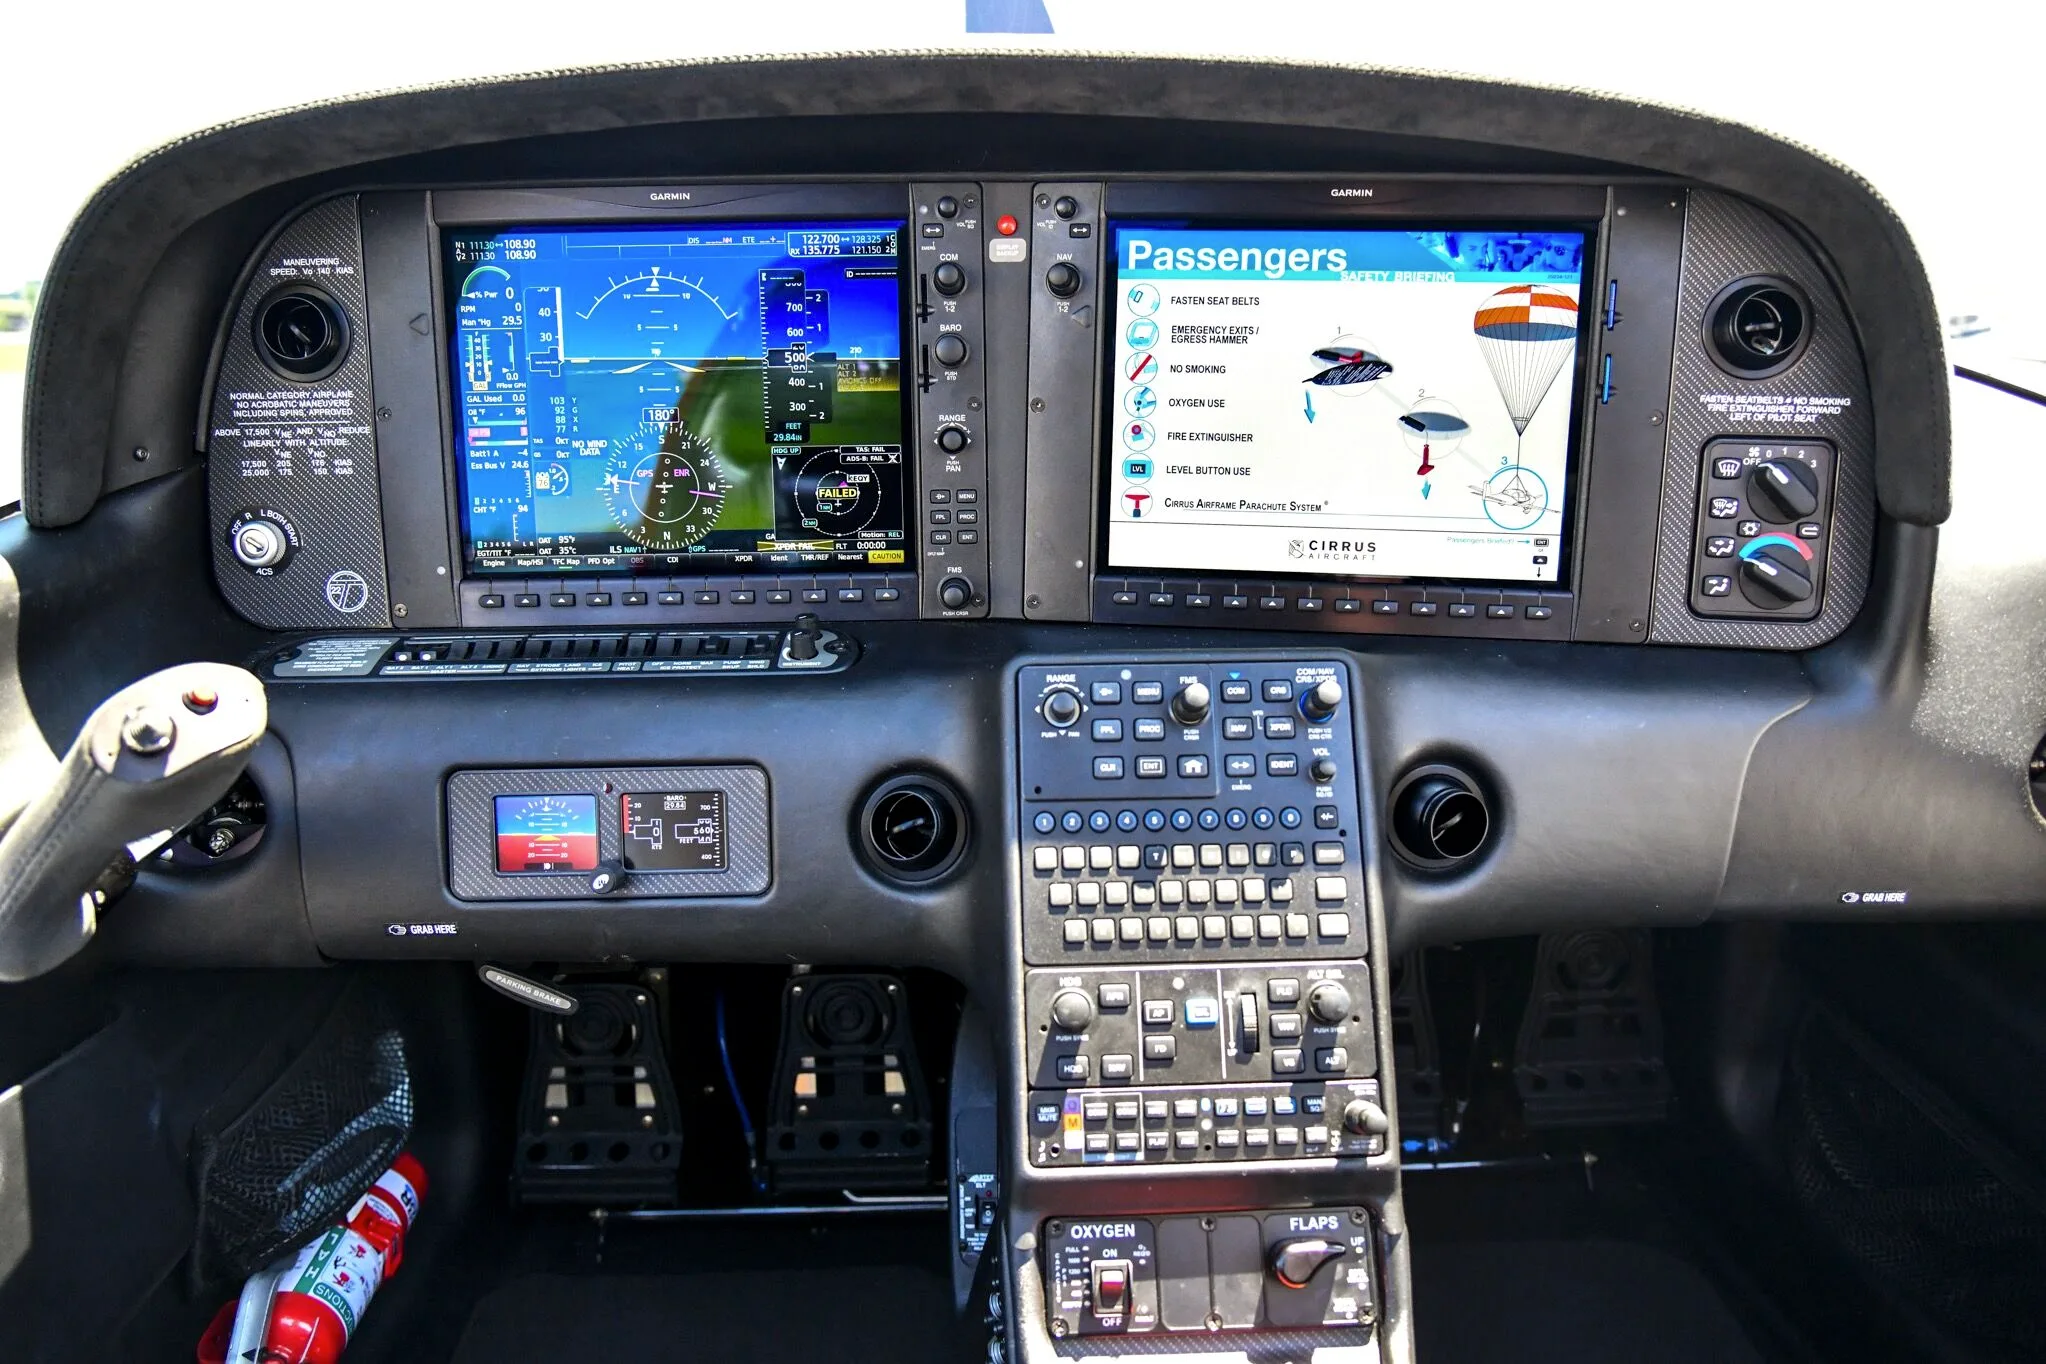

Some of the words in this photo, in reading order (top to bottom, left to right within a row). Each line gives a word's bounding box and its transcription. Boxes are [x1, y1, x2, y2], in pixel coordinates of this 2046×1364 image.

[650, 192, 690, 200] GARMIN
[1330, 189, 1373, 197] GARMIN
[802, 235, 840, 244] 122.700
[852, 236, 881, 244] 128.325
[470, 241, 494, 250] 111.30
[504, 239, 536, 249] 108.90
[802, 245, 840, 255] 135.775
[852, 246, 881, 254] 121.150
[470, 252, 495, 260] 111.30
[504, 250, 536, 260] 108.90
[1128, 240, 1347, 279] Passengers
[270, 268, 297, 276] SPEED:
[1341, 271, 1390, 281] SAFETY
[1394, 271, 1455, 282] BRIEFING
[505, 287, 514, 299] 0
[1171, 297, 1205, 305] FASTEN
[1207, 297, 1230, 305] SEAT
[1232, 297, 1260, 306] BELTS
[786, 303, 802, 312] 700
[538, 308, 551, 317] 40
[502, 316, 522, 326] 29.5
[787, 328, 803, 337] 600
[1172, 326, 1227, 335] EMERGENCY
[1229, 326, 1254, 335] EXITS
[540, 333, 552, 341] 30
[1171, 335, 1207, 344] EGRESS
[1210, 335, 1248, 344] HAMMER
[784, 352, 805, 363] 500
[1170, 365, 1183, 373] NO
[1185, 365, 1226, 374] SMOKING
[788, 378, 805, 386] 400
[1169, 399, 1205, 407] OXYGEN
[1208, 399, 1225, 408] USE
[1700, 395, 1734, 403] FASTEN
[1736, 395, 1784, 404] SEATBELTS
[1794, 397, 1807, 405] NO
[1809, 397, 1851, 406] SMOKING
[789, 402, 806, 410] 300
[1730, 404, 1795, 413] EXTINGUISHER
[1796, 406, 1841, 414] FORWARD
[1794, 414, 1818, 422] SEAT
[1168, 432, 1186, 441] FIRE
[1189, 433, 1253, 442] EXTINGUISHER
[1501, 456, 1508, 465] 3
[1166, 466, 1193, 474] LEVEL
[1196, 466, 1231, 475] BUTTON
[1233, 467, 1251, 476] USE
[819, 488, 857, 498] FAILED
[267, 510, 286, 527] BOTH
[284, 521, 299, 547] START
[664, 531, 671, 541] N
[1309, 540, 1376, 552] CIRRUS
[256, 568, 273, 576] ACS
[1046, 674, 1076, 682] RANGE
[1313, 748, 1330, 756] VOL
[1862, 893, 1884, 902] GRAB
[1884, 892, 1906, 902] HERE
[410, 924, 434, 934] GRAB
[434, 924, 457, 934] HERE
[1307, 970, 1324, 979] ALT
[496, 976, 531, 994] PARKING
[532, 988, 561, 1005] BRAKE
[1153, 1009, 1165, 1017] AP
[1325, 1056, 1340, 1065] ALT
[1037, 1114, 1058, 1122] MUTE
[1290, 1215, 1339, 1231] FLAPS
[1071, 1224, 1136, 1239] OXYGEN
[1350, 1237, 1365, 1246] UP
[1103, 1249, 1118, 1258] ON
[1102, 1318, 1122, 1327] OFF
